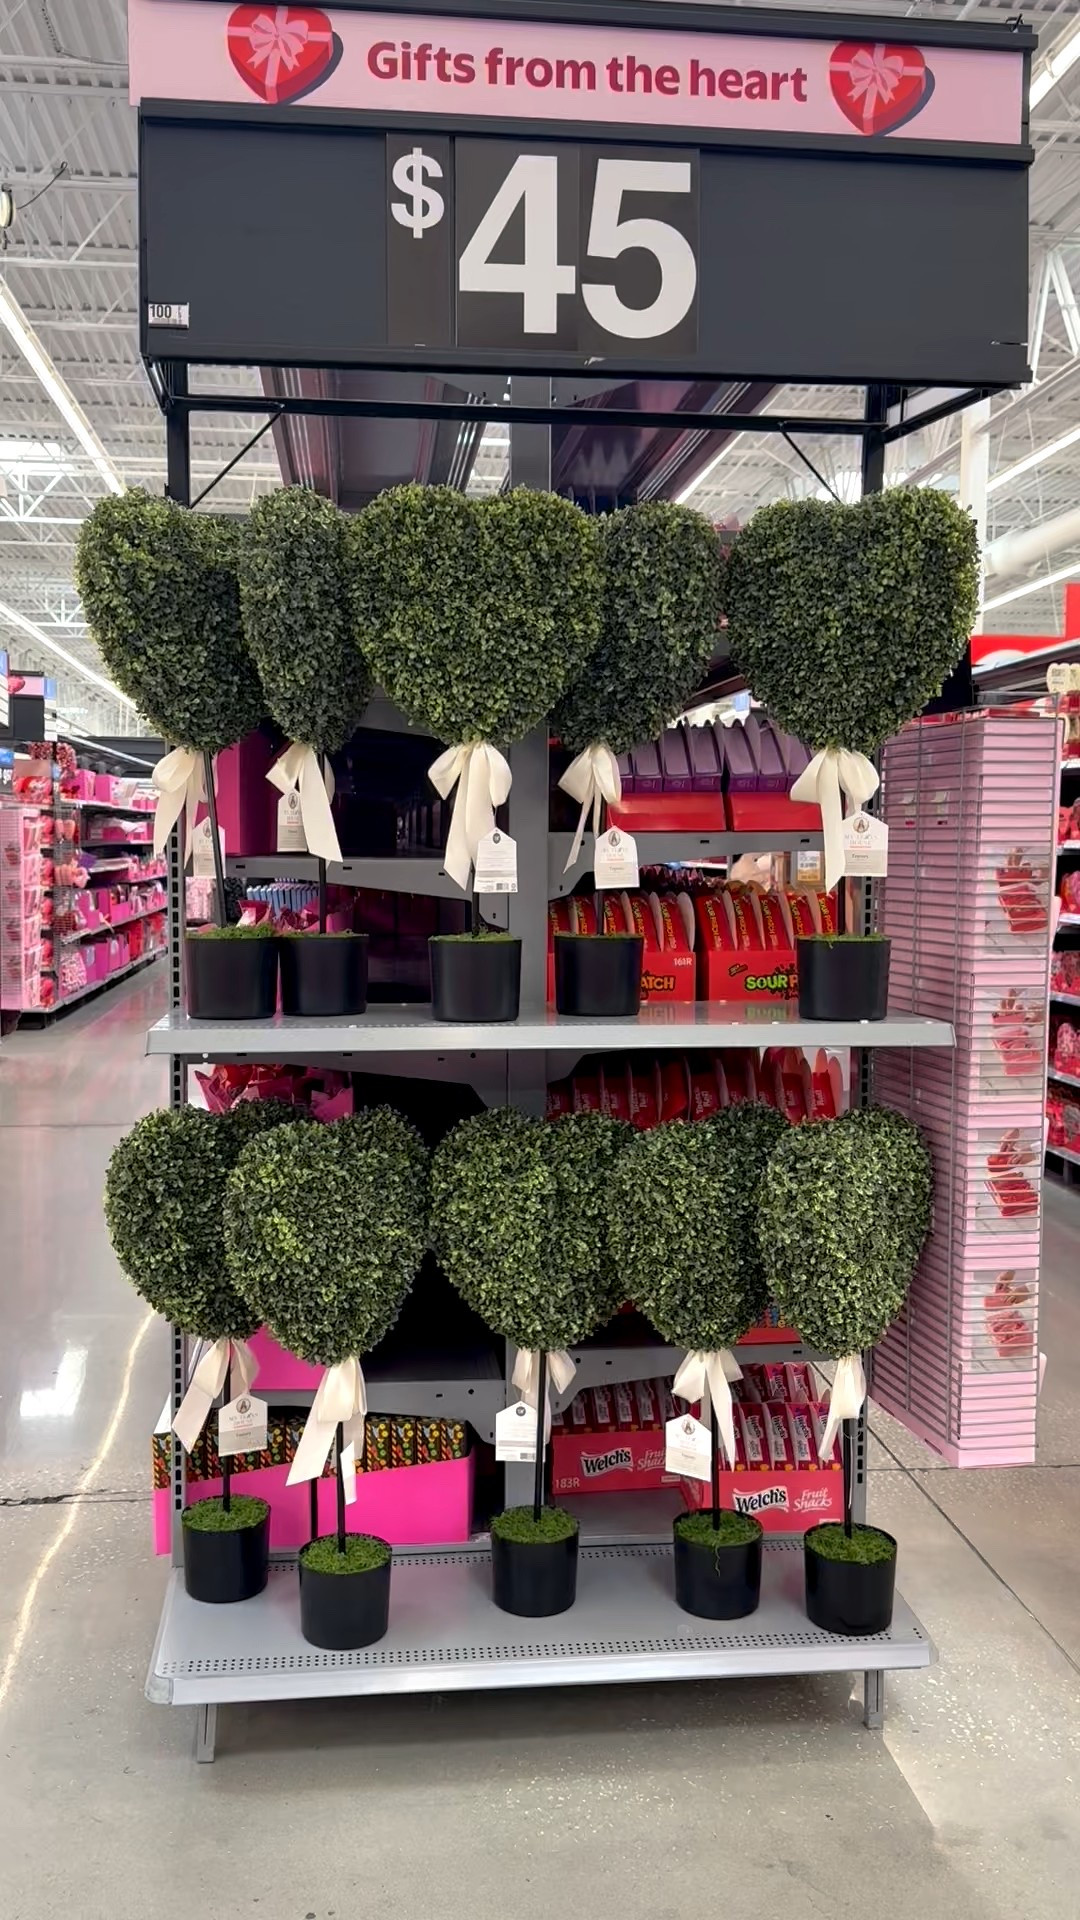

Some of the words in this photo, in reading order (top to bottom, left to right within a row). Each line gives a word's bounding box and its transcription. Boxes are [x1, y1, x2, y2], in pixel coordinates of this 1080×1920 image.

[367, 41, 476, 84] Gifts
[484, 48, 597, 91] from
[605, 55, 681, 94] the
[689, 59, 808, 103] heart
[747, 975, 787, 989] SOUR
[584, 1450, 631, 1474] Welch's
[555, 1477, 581, 1489] 183R
[735, 1488, 787, 1512] Welch's
[801, 1487, 829, 1501] Fruit
[793, 1496, 833, 1512] Snacks
